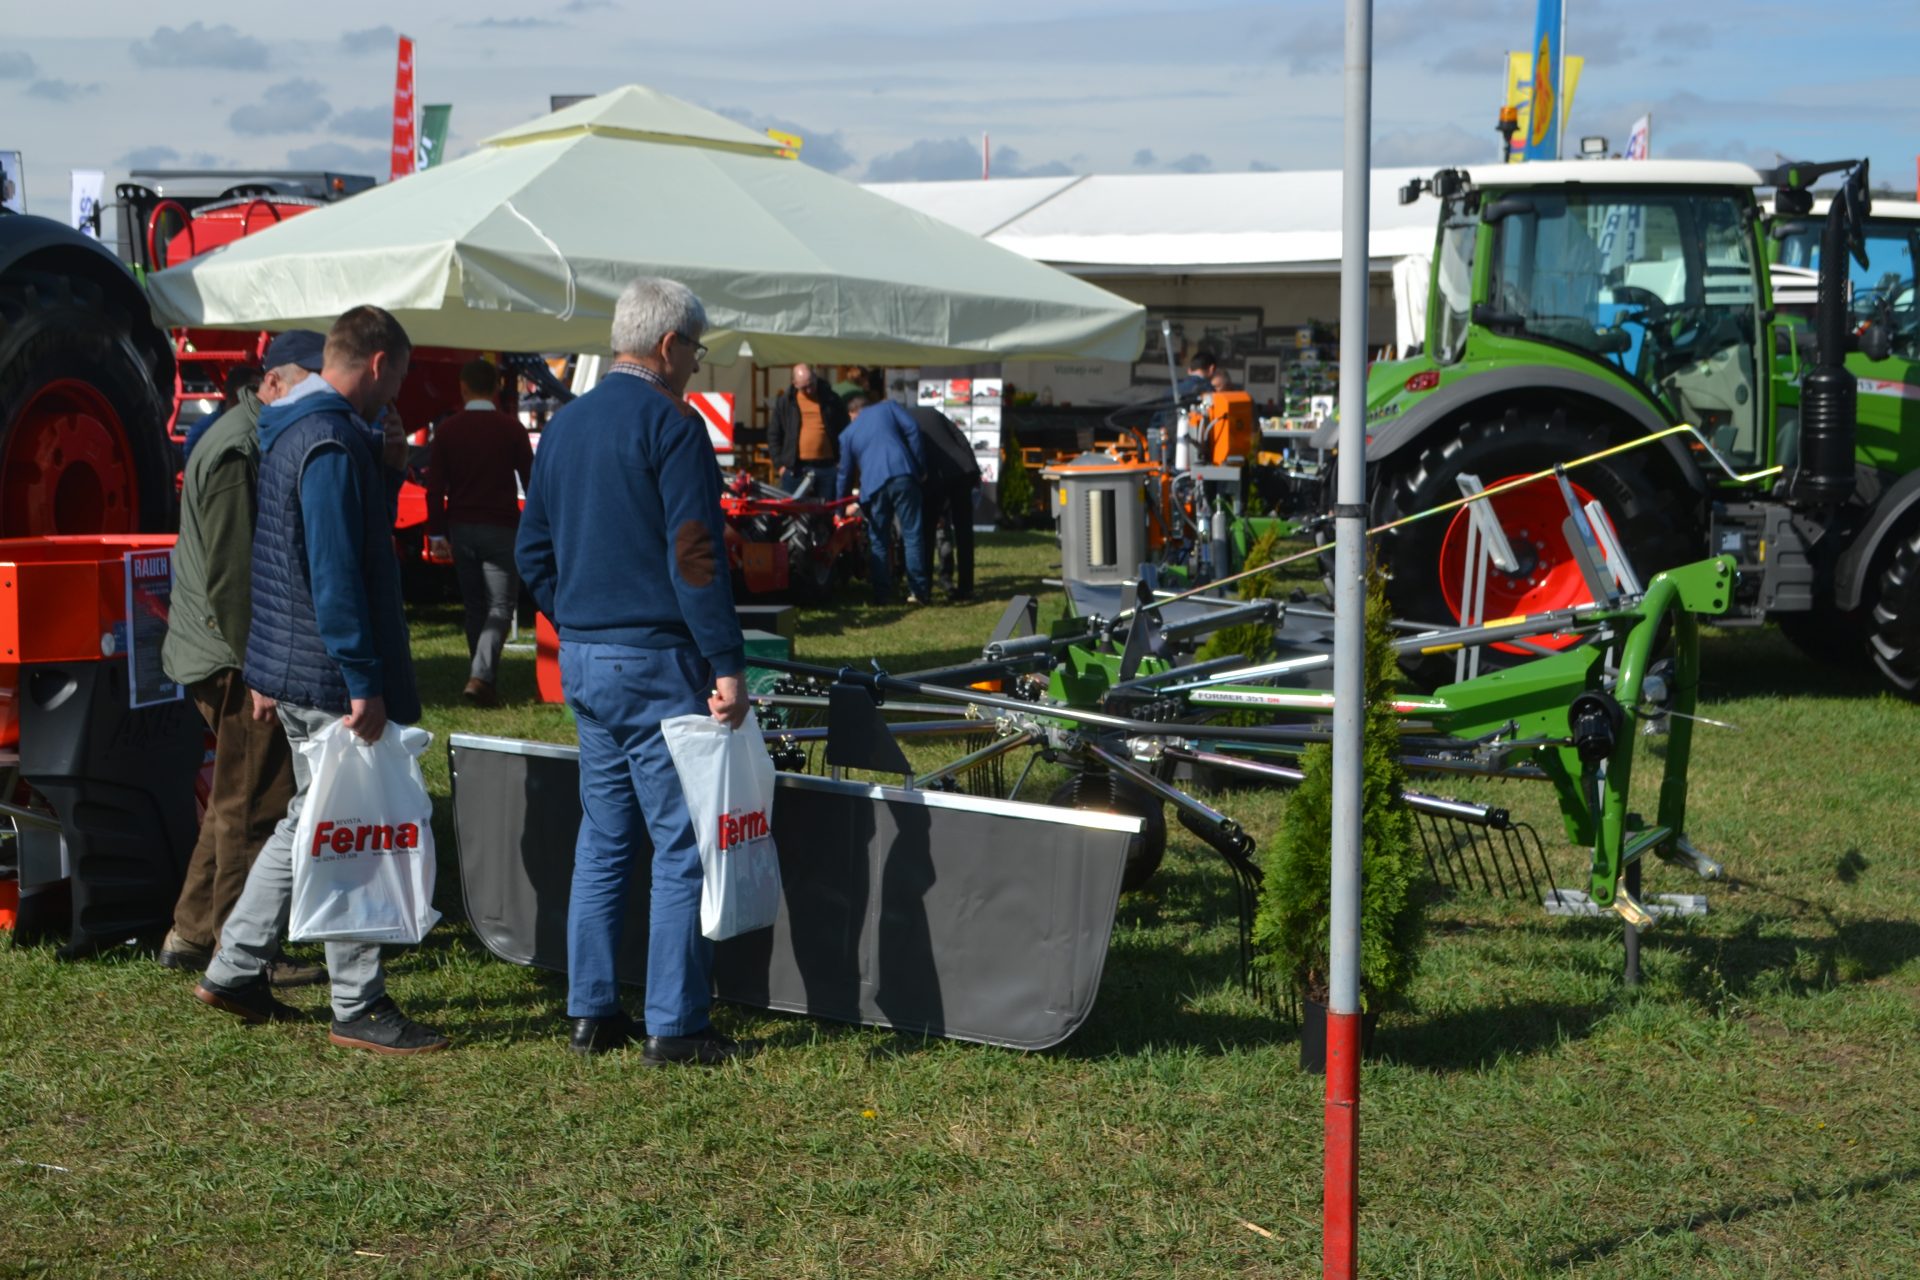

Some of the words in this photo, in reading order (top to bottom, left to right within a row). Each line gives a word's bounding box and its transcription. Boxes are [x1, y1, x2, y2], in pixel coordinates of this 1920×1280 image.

[134, 557, 168, 577] RAUCH
[1198, 692, 1243, 701] FORMER
[336, 818, 362, 826] REVISTA
